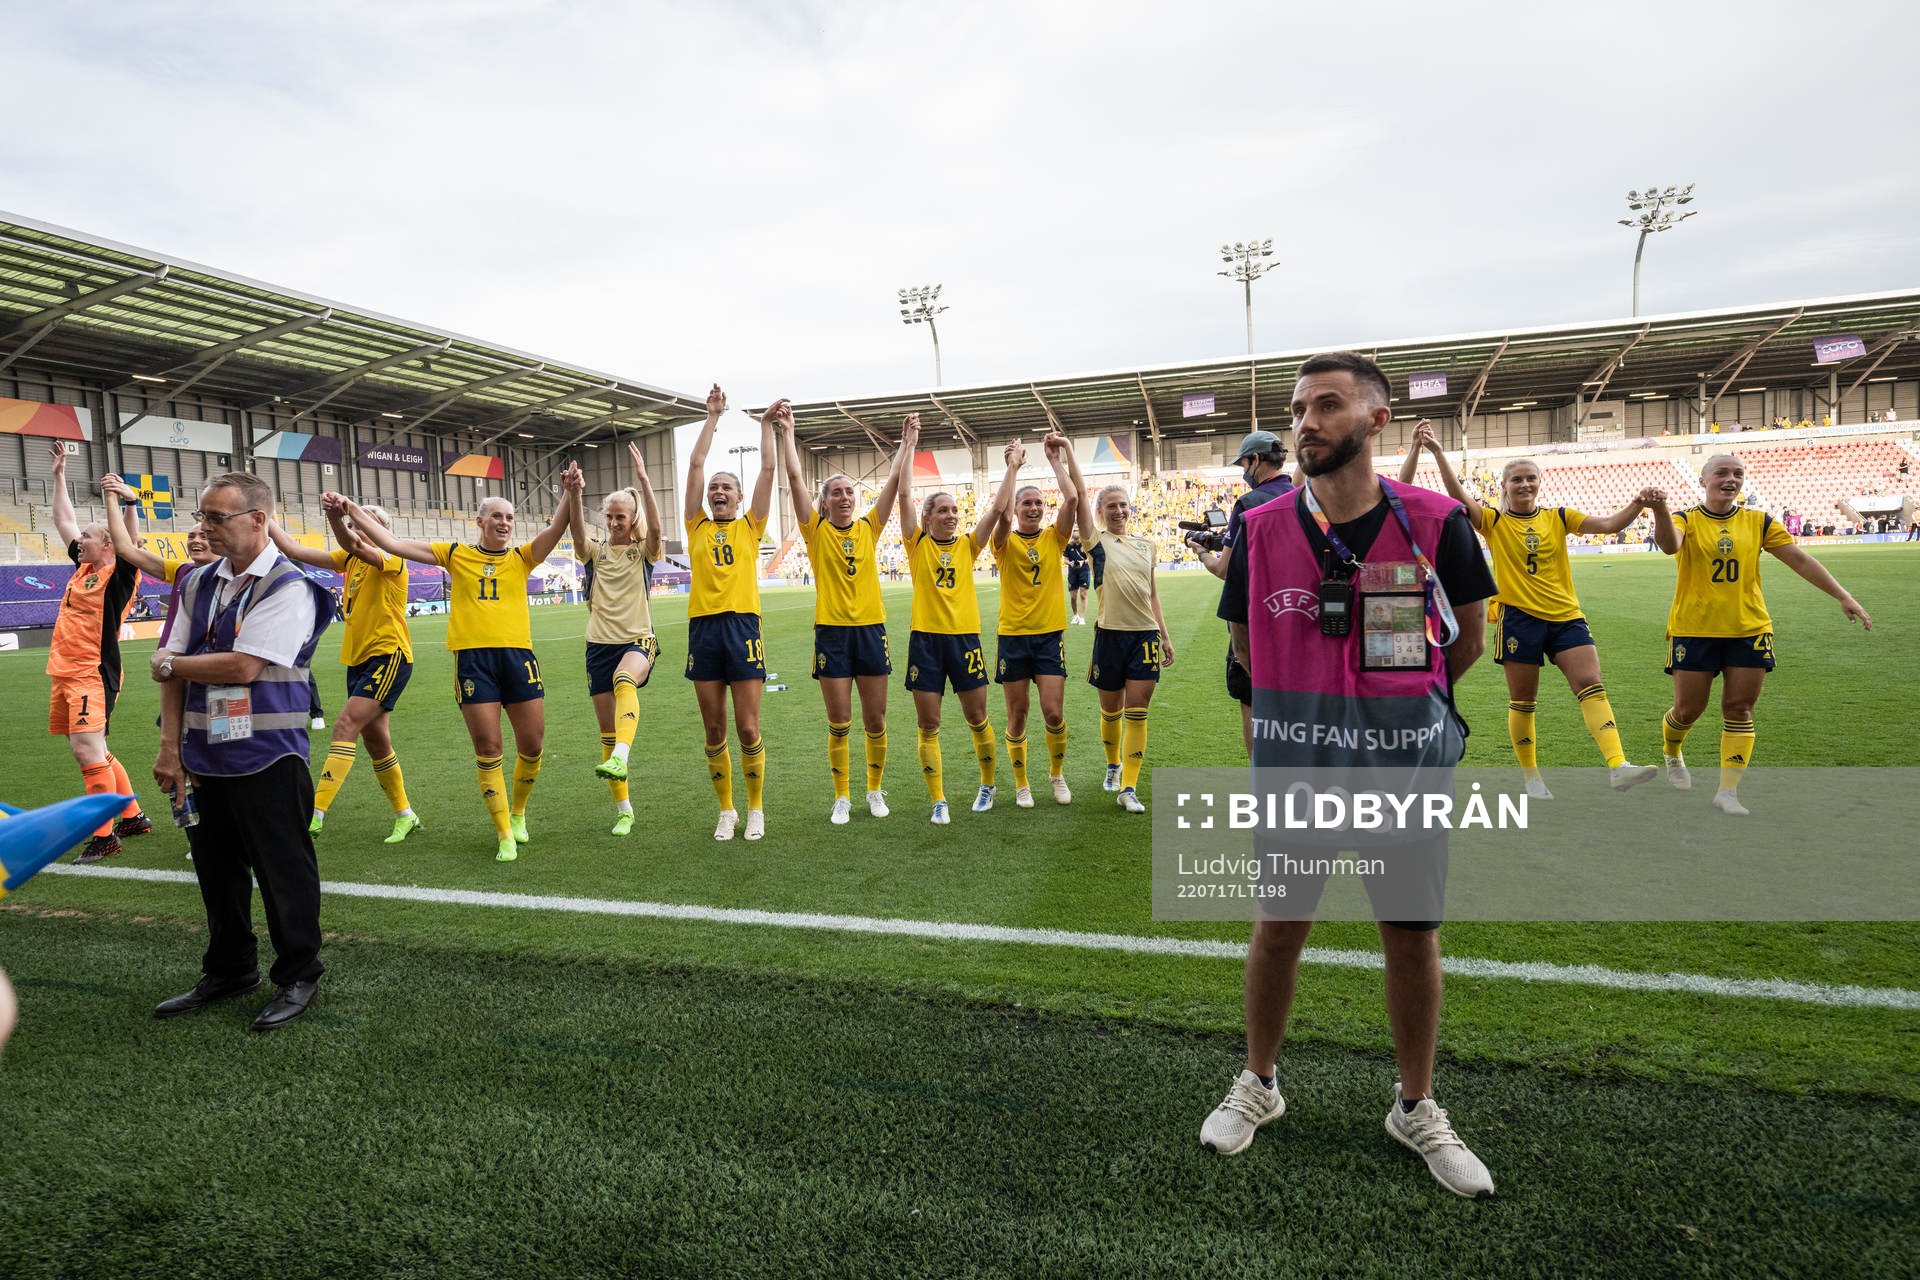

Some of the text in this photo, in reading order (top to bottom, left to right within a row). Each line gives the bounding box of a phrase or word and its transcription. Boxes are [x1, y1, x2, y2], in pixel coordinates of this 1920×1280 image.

[1413, 380, 1440, 389] UEFA
[69, 444, 76, 453] D
[394, 453, 400, 462] &
[401, 454, 423, 464] LEIGH
[712, 544, 735, 567] 18
[846, 556, 857, 576] 3
[1527, 553, 1538, 576] 5
[935, 567, 956, 589] 23
[1031, 565, 1042, 586] 2
[1711, 558, 1739, 583] 20
[66, 588, 73, 607] 1
[477, 578, 500, 600] 11
[1266, 593, 1320, 617] UEFA
[745, 639, 763, 663] 18
[964, 648, 984, 674] 23
[1142, 641, 1159, 664] 15
[371, 664, 385, 685] 4
[524, 659, 542, 684] 11
[78, 695, 89, 715] 1
[1252, 717, 1307, 743] TING
[1312, 723, 1358, 750] FAN
